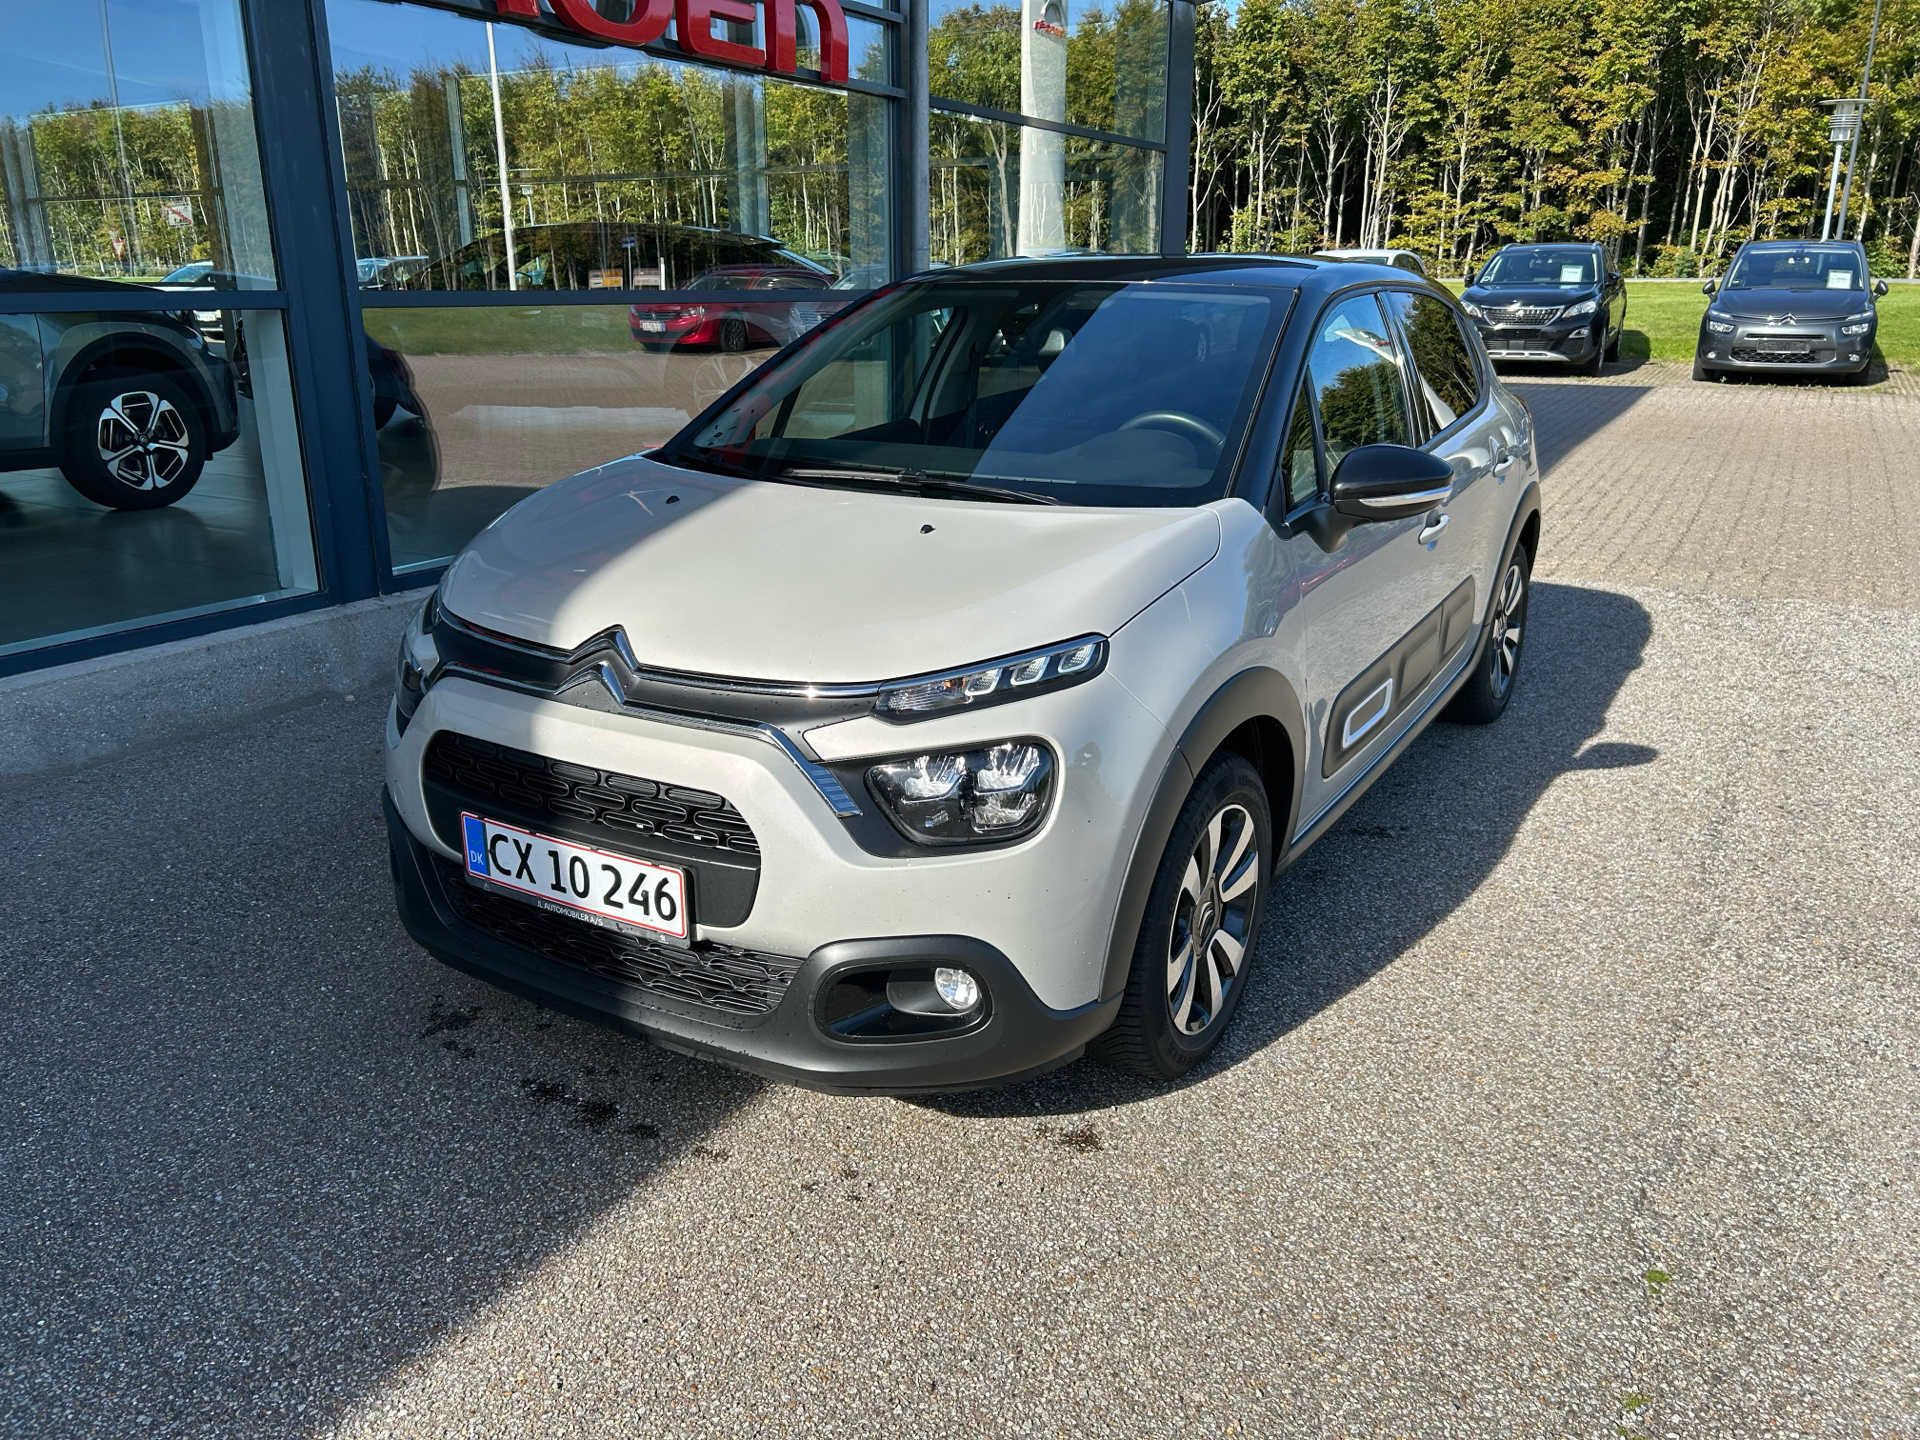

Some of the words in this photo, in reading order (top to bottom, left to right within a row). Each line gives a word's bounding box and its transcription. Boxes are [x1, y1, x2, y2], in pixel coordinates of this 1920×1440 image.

[470, 850, 485, 866] DK
[489, 833, 537, 884] CX
[548, 850, 591, 899] 10
[601, 863, 677, 921] 246
[544, 902, 590, 923] AUTOMOBILER
[590, 917, 604, 926] A/S
